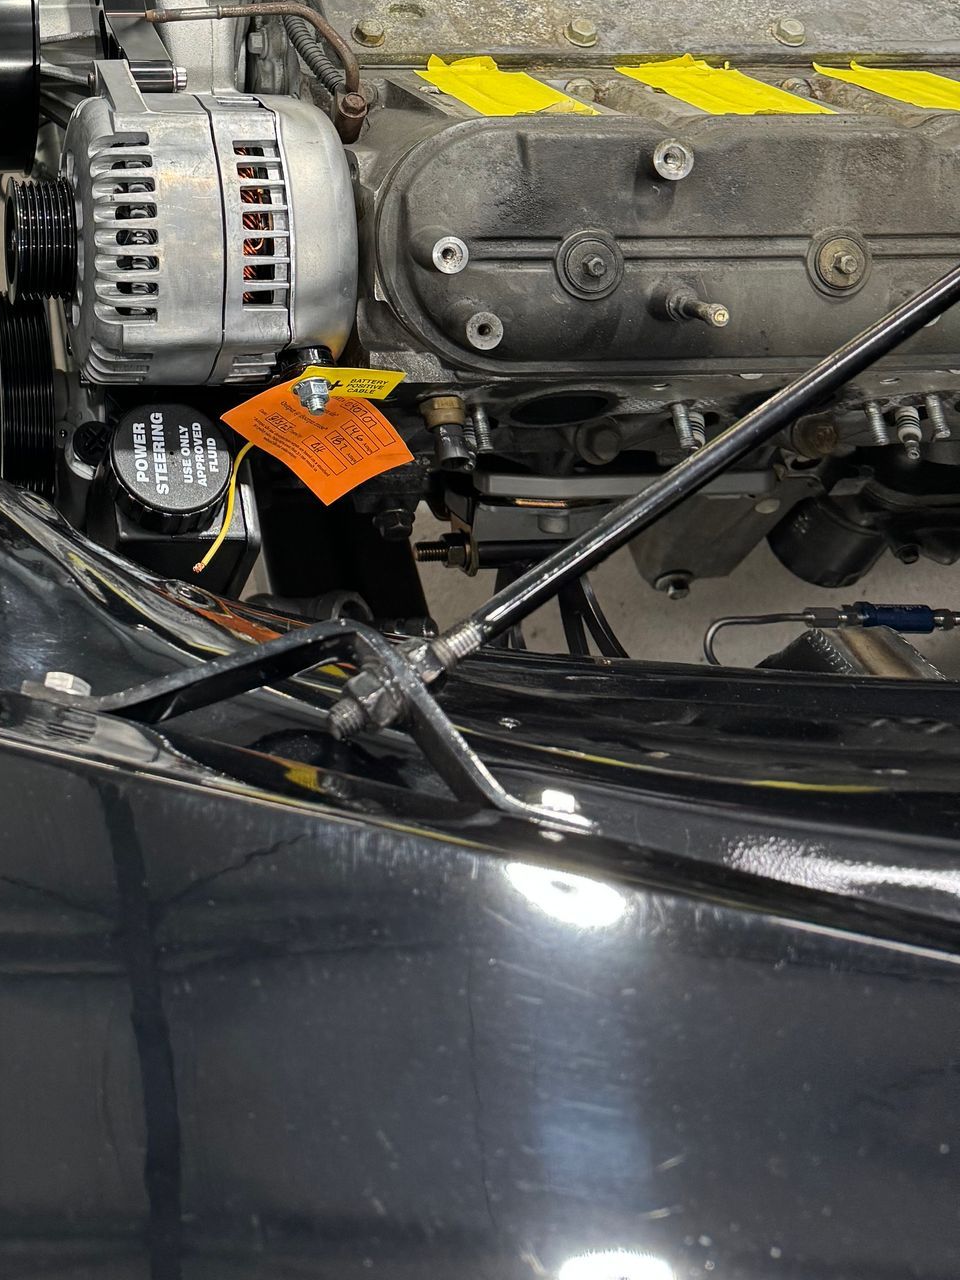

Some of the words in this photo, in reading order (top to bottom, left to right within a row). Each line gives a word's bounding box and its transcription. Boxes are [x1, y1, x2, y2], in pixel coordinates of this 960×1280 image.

[133, 422, 149, 482] POWER
[150, 412, 169, 495] STEERING
[179, 425, 191, 456] ONLY
[192, 422, 207, 487] APPROVED
[206, 437, 219, 472] FLUID
[182, 458, 194, 484] USE
